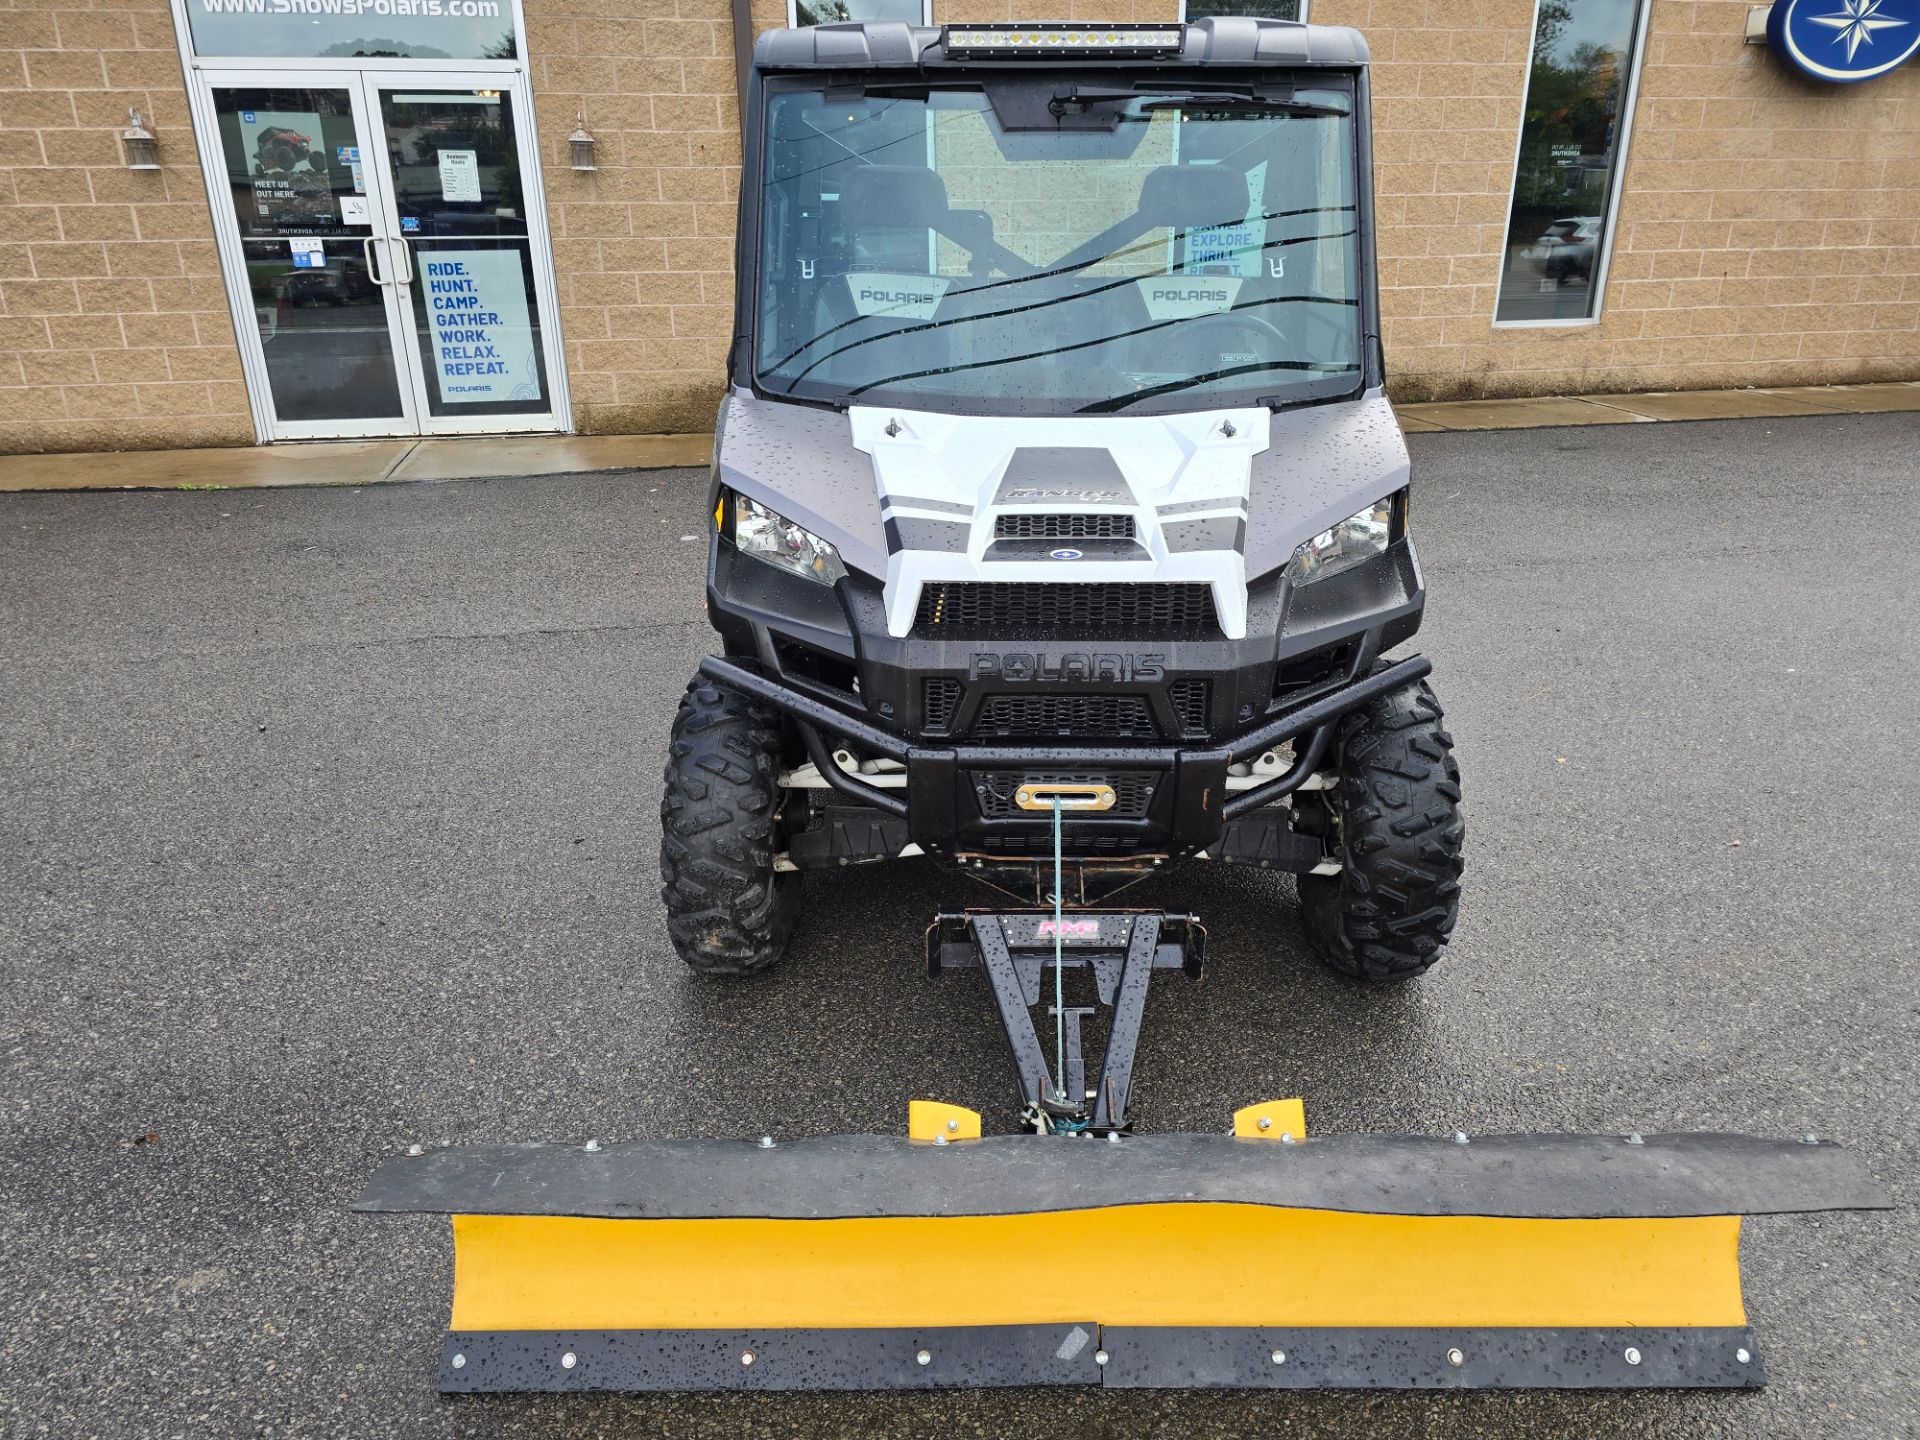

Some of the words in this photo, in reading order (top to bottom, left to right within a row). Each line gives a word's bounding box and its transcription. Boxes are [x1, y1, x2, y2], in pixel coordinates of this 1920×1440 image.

[254, 180, 276, 188] MEET
[278, 180, 289, 188] US
[256, 190, 272, 198] OUT
[274, 190, 298, 198] HERE.
[1191, 233, 1254, 247] EXPLORE.
[427, 262, 469, 276] RIDE.
[430, 279, 478, 293] HUNT.
[860, 290, 934, 304] POLARIS
[1152, 290, 1227, 301] POLARIS
[433, 296, 483, 310] CAMP.
[436, 312, 504, 326] GATHER.
[439, 329, 491, 343] WORK.
[441, 346, 500, 359] RELAX.
[444, 361, 509, 376] REPEAT.
[447, 385, 492, 393] POLARIS
[969, 653, 1165, 682] POLARIS
